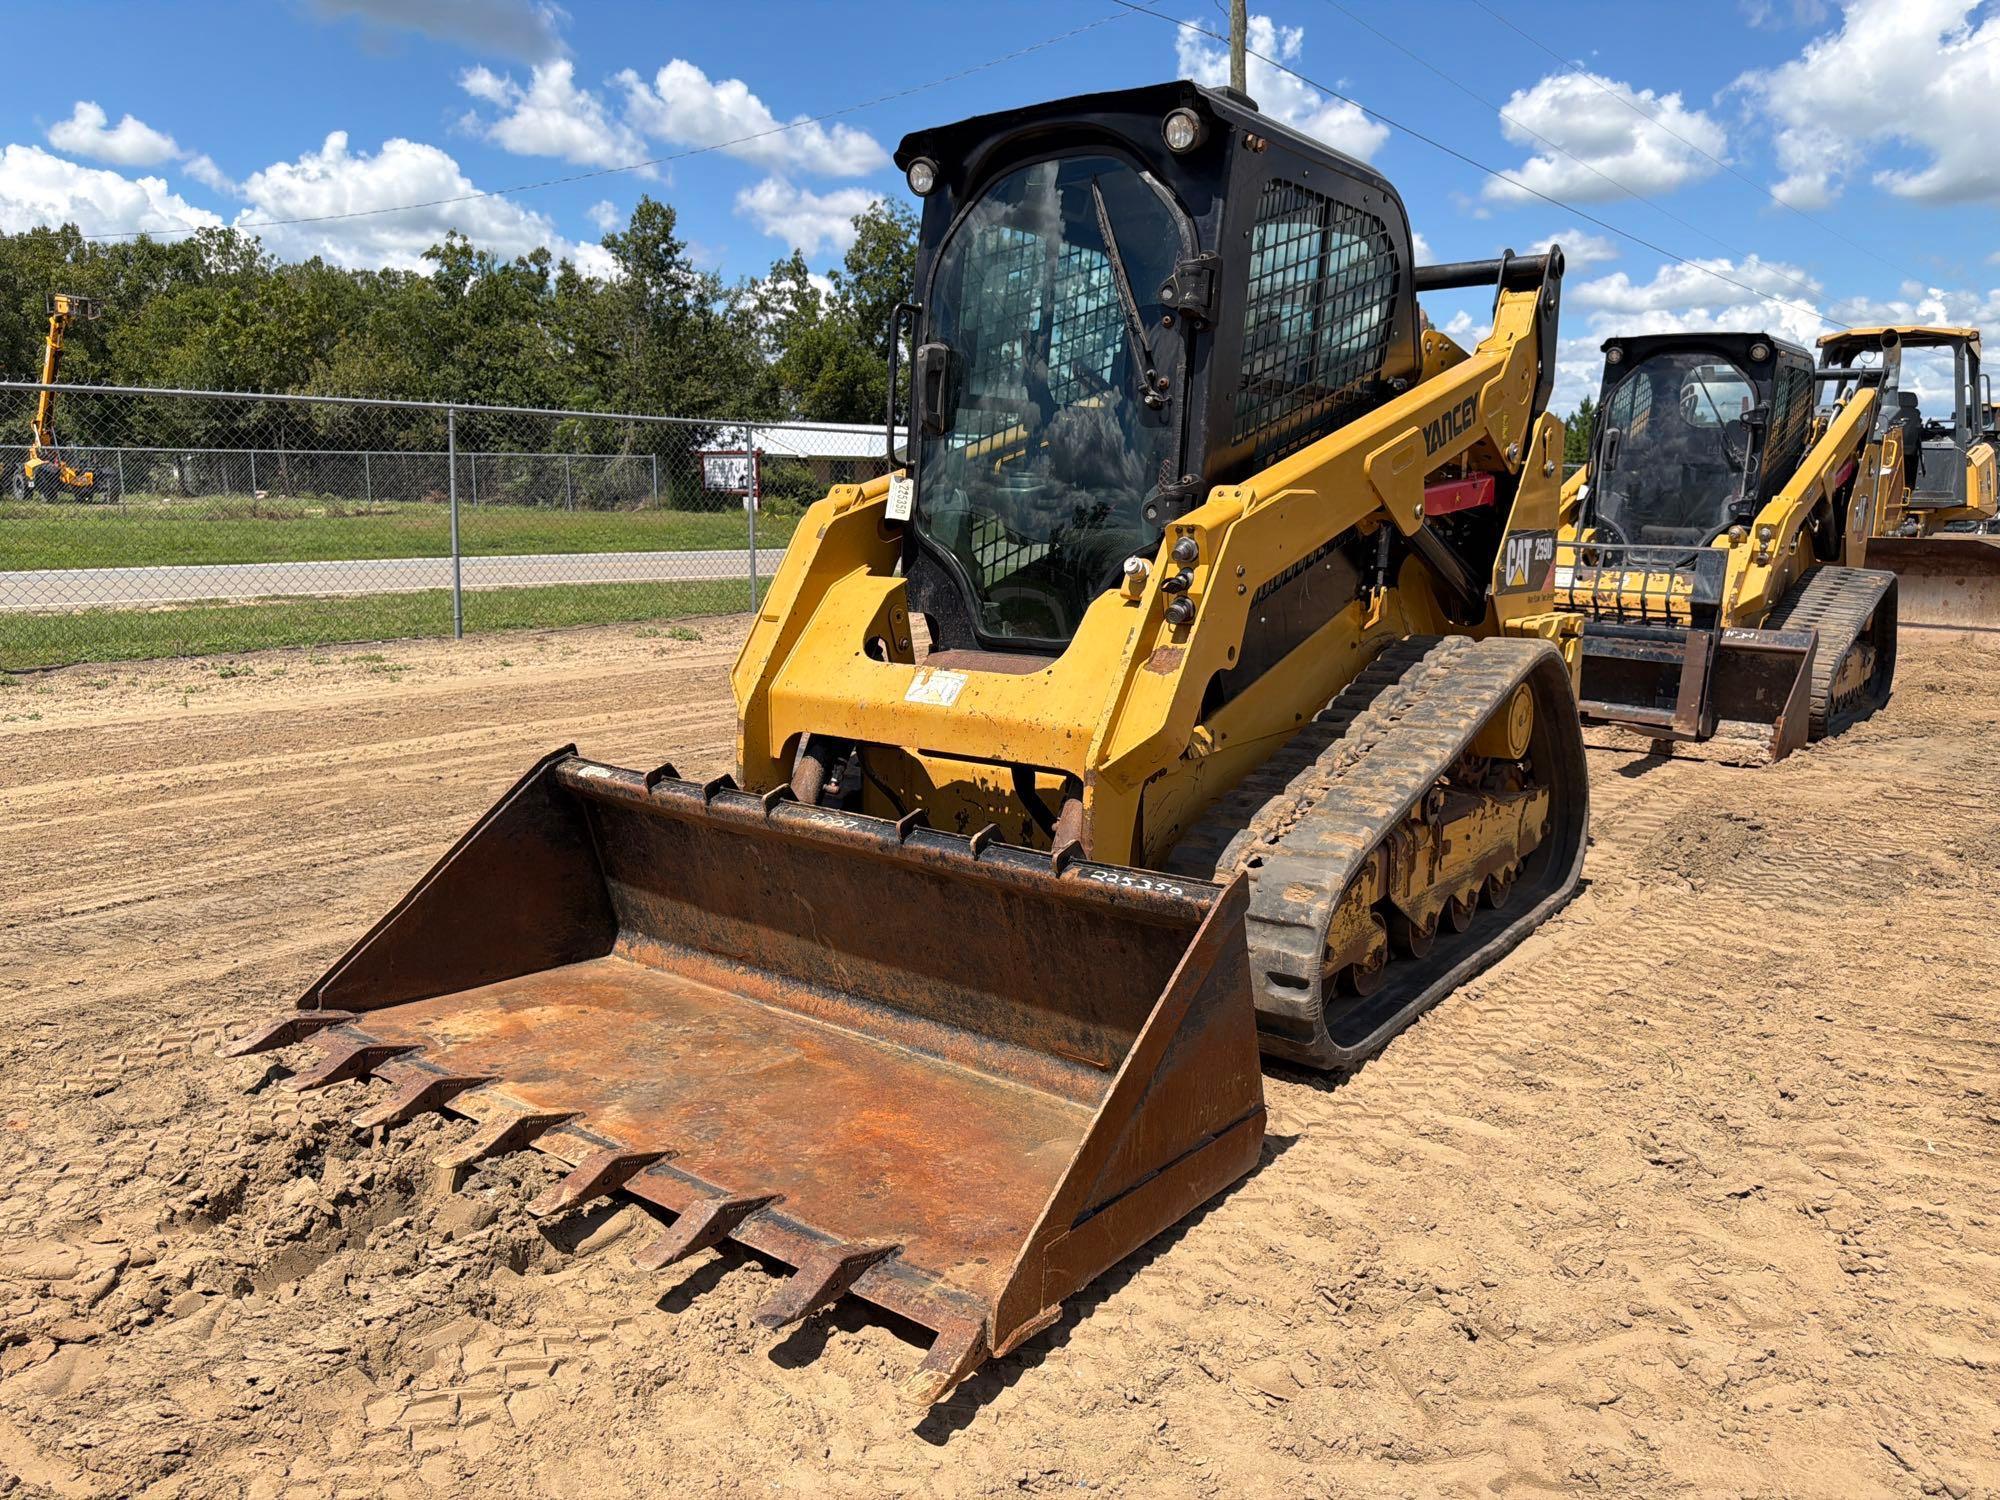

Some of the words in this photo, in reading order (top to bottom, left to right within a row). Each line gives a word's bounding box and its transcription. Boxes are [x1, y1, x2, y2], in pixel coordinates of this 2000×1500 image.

[1422, 392, 1478, 457] YANCEY
[1505, 538, 1533, 587] CAT
[1535, 537, 1553, 560] 259D
[1090, 870, 1183, 895] 225350
